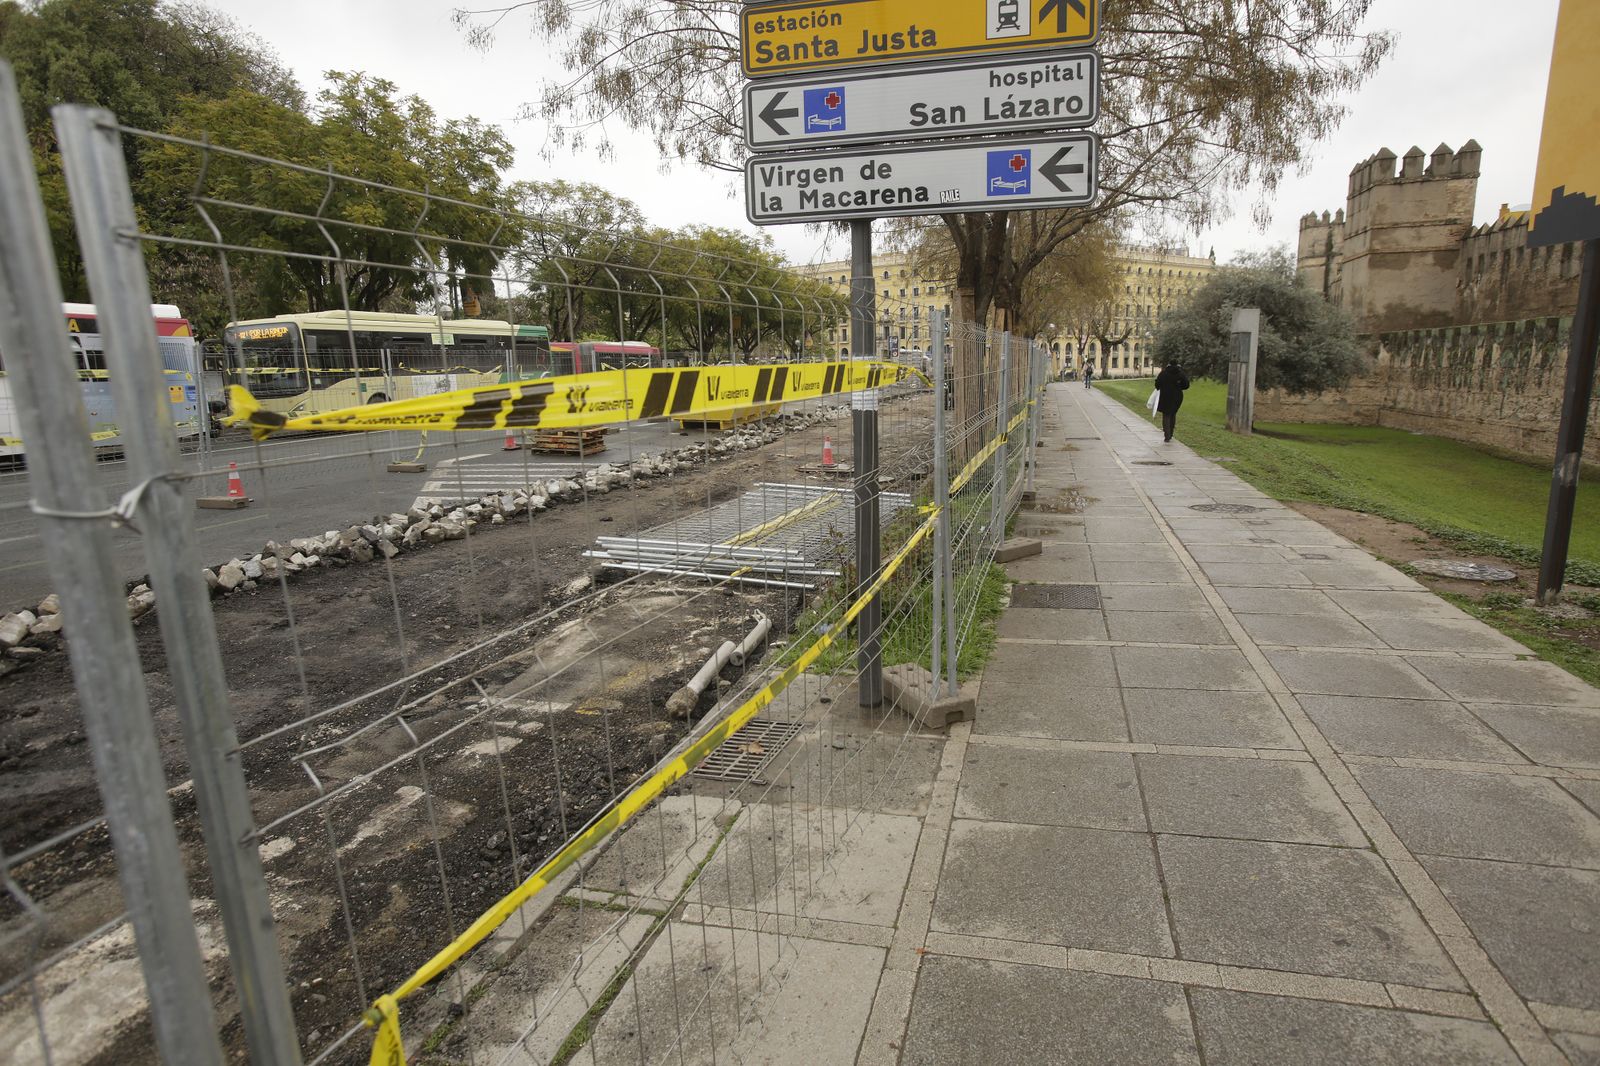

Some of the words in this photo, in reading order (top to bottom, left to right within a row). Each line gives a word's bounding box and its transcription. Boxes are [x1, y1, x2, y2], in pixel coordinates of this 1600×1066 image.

[754, 10, 842, 34] estación
[755, 35, 839, 64] Santa
[857, 25, 937, 54] Justa
[989, 62, 1083, 88] hospital
[909, 102, 966, 126] San
[984, 94, 1083, 121] Lázaro
[760, 165, 844, 188] Virgen
[860, 160, 892, 180] de
[761, 192, 783, 212] la
[800, 185, 929, 210] Macarena
